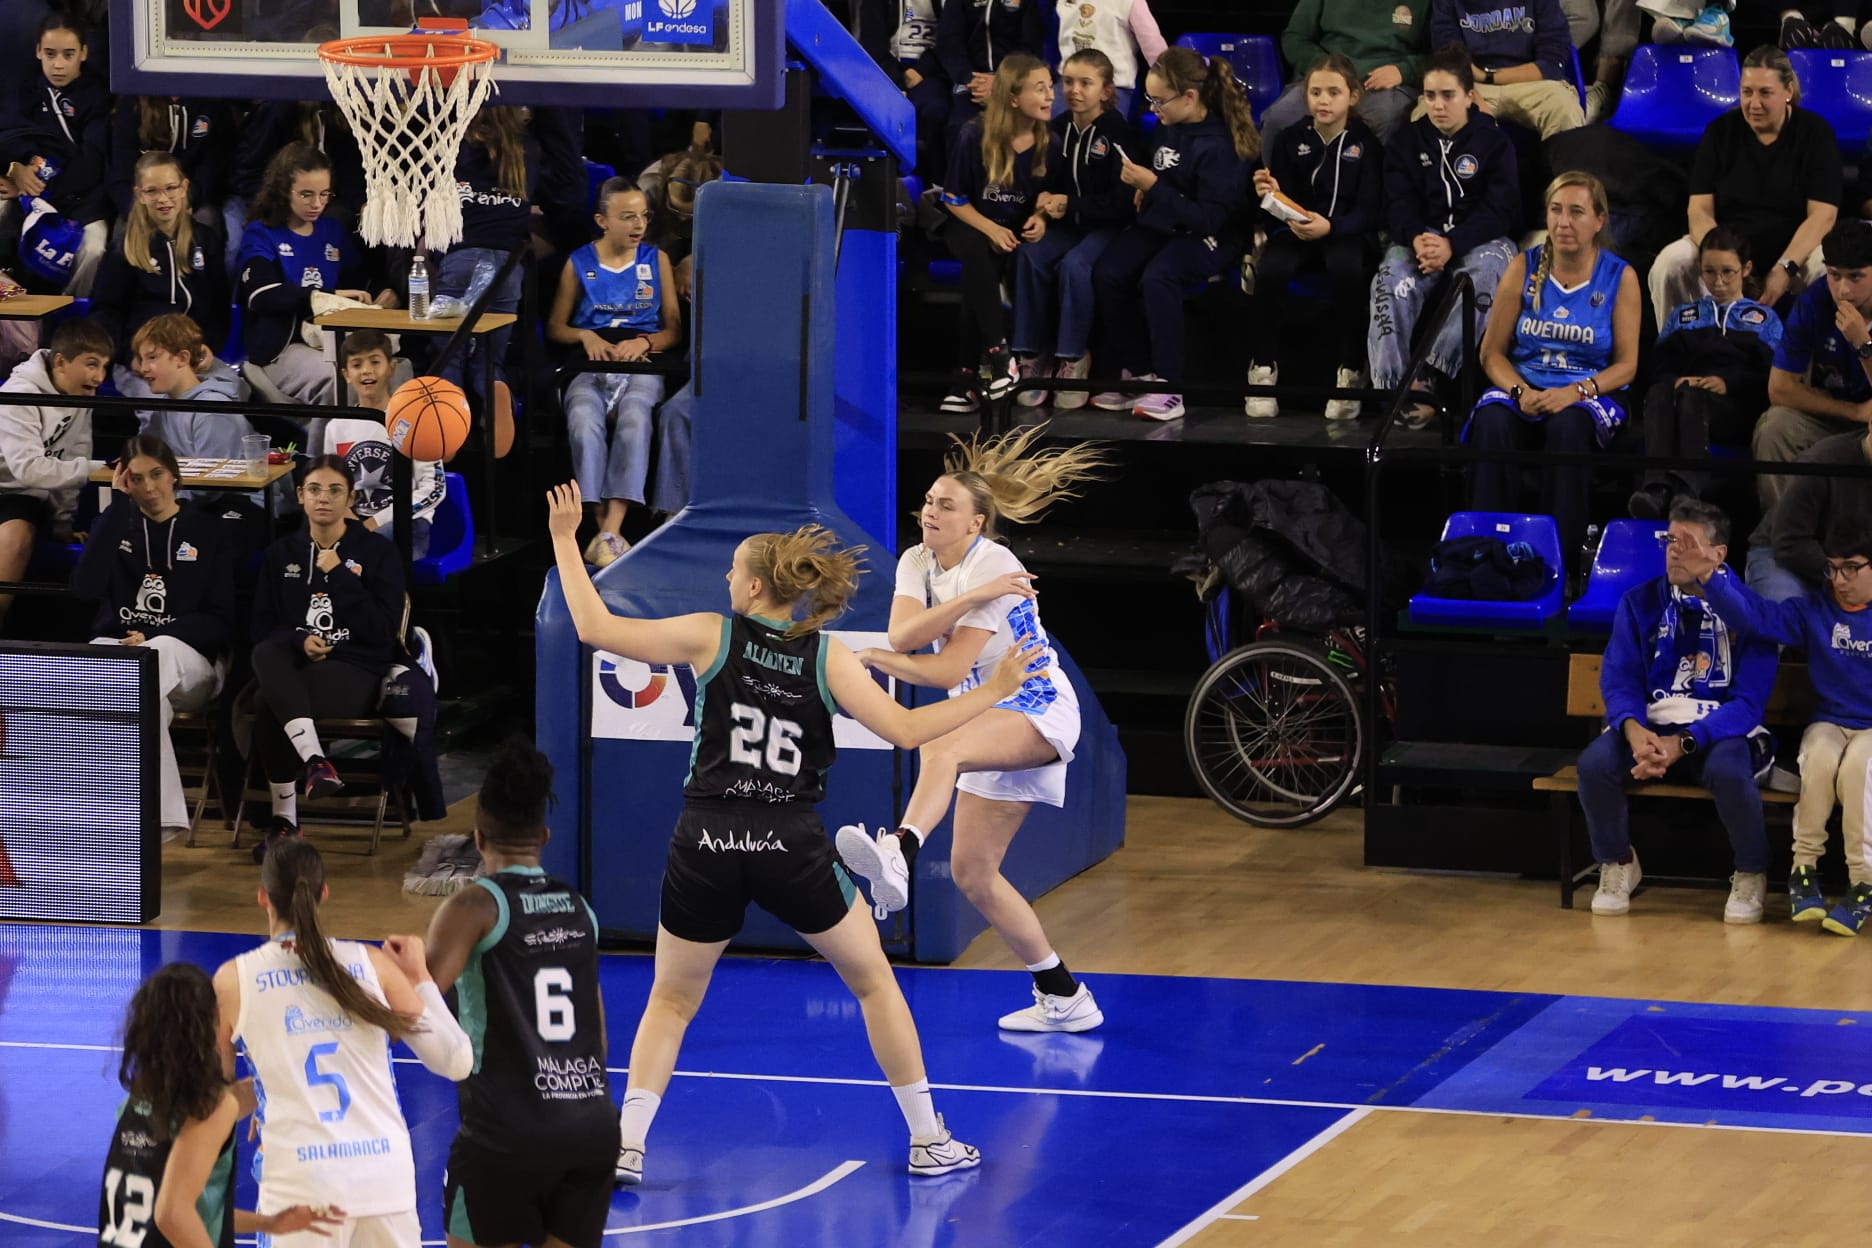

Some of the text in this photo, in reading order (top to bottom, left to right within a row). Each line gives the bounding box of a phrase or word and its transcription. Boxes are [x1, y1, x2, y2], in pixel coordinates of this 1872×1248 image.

[648, 22, 707, 34] LF endesa
[909, 24, 936, 39] 22
[1459, 6, 1526, 33] JORDAN
[1521, 317, 1594, 345] AVENIDA
[730, 702, 804, 777] 26
[697, 828, 789, 853] Andalucía
[534, 967, 577, 1042] 6
[304, 1042, 352, 1123] 5
[297, 1137, 391, 1162] SALAMANCA
[101, 1167, 155, 1248] 12
